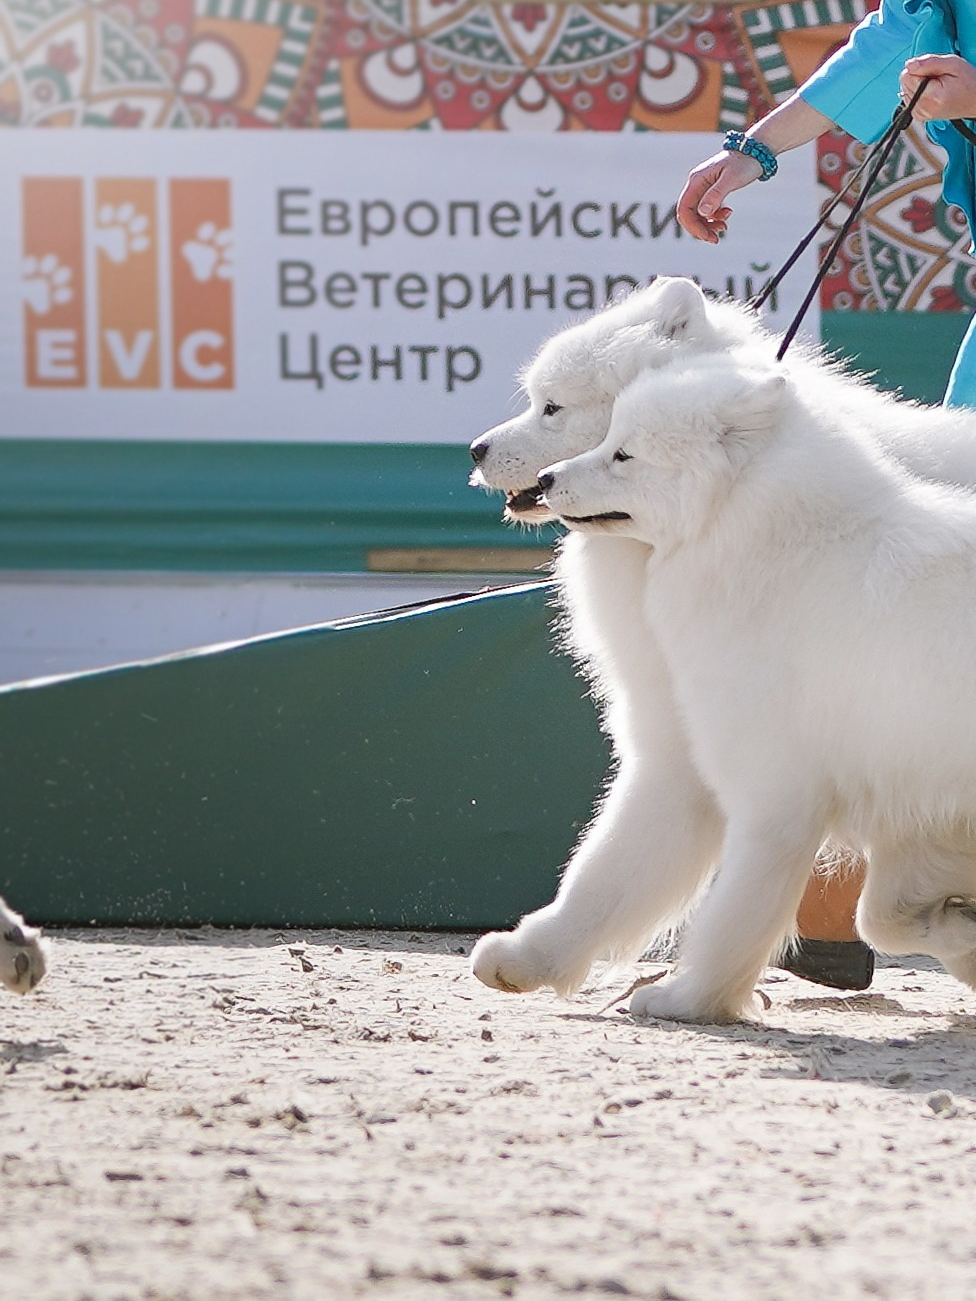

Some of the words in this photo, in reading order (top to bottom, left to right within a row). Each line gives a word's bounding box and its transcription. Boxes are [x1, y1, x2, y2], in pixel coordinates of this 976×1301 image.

[276, 186, 726, 246] Европейски
[36, 329, 227, 382] EVC
[278, 333, 483, 392] Центр
